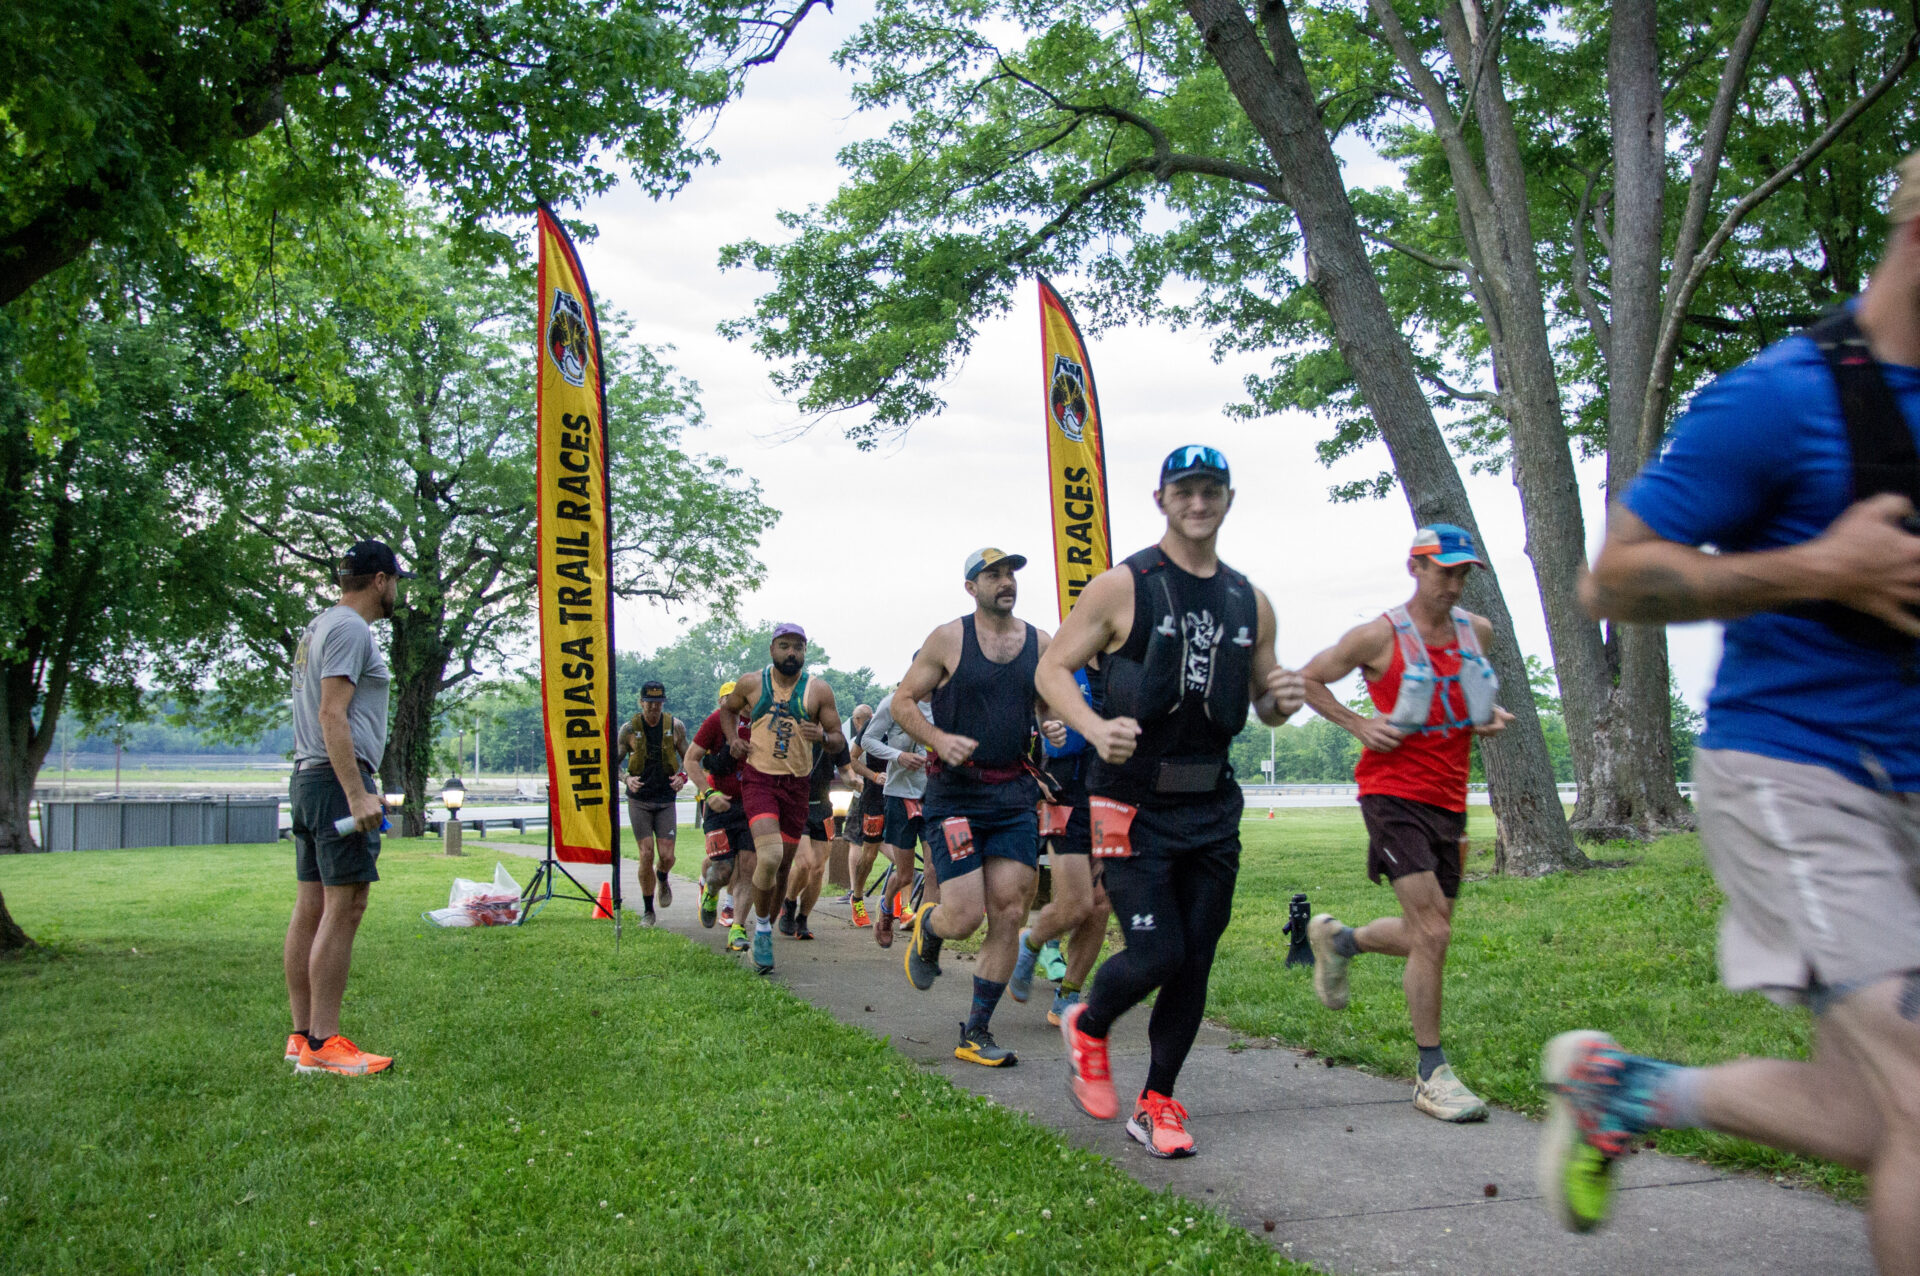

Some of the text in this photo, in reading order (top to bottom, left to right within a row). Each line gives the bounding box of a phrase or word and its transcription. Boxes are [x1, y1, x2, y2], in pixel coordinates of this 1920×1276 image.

[556, 412, 592, 522] RACES
[1064, 467, 1094, 565] RACES
[556, 532, 593, 625] TRAIL
[561, 637, 600, 738] PIASA
[567, 748, 603, 811] THE
[1094, 820, 1104, 845] 5
